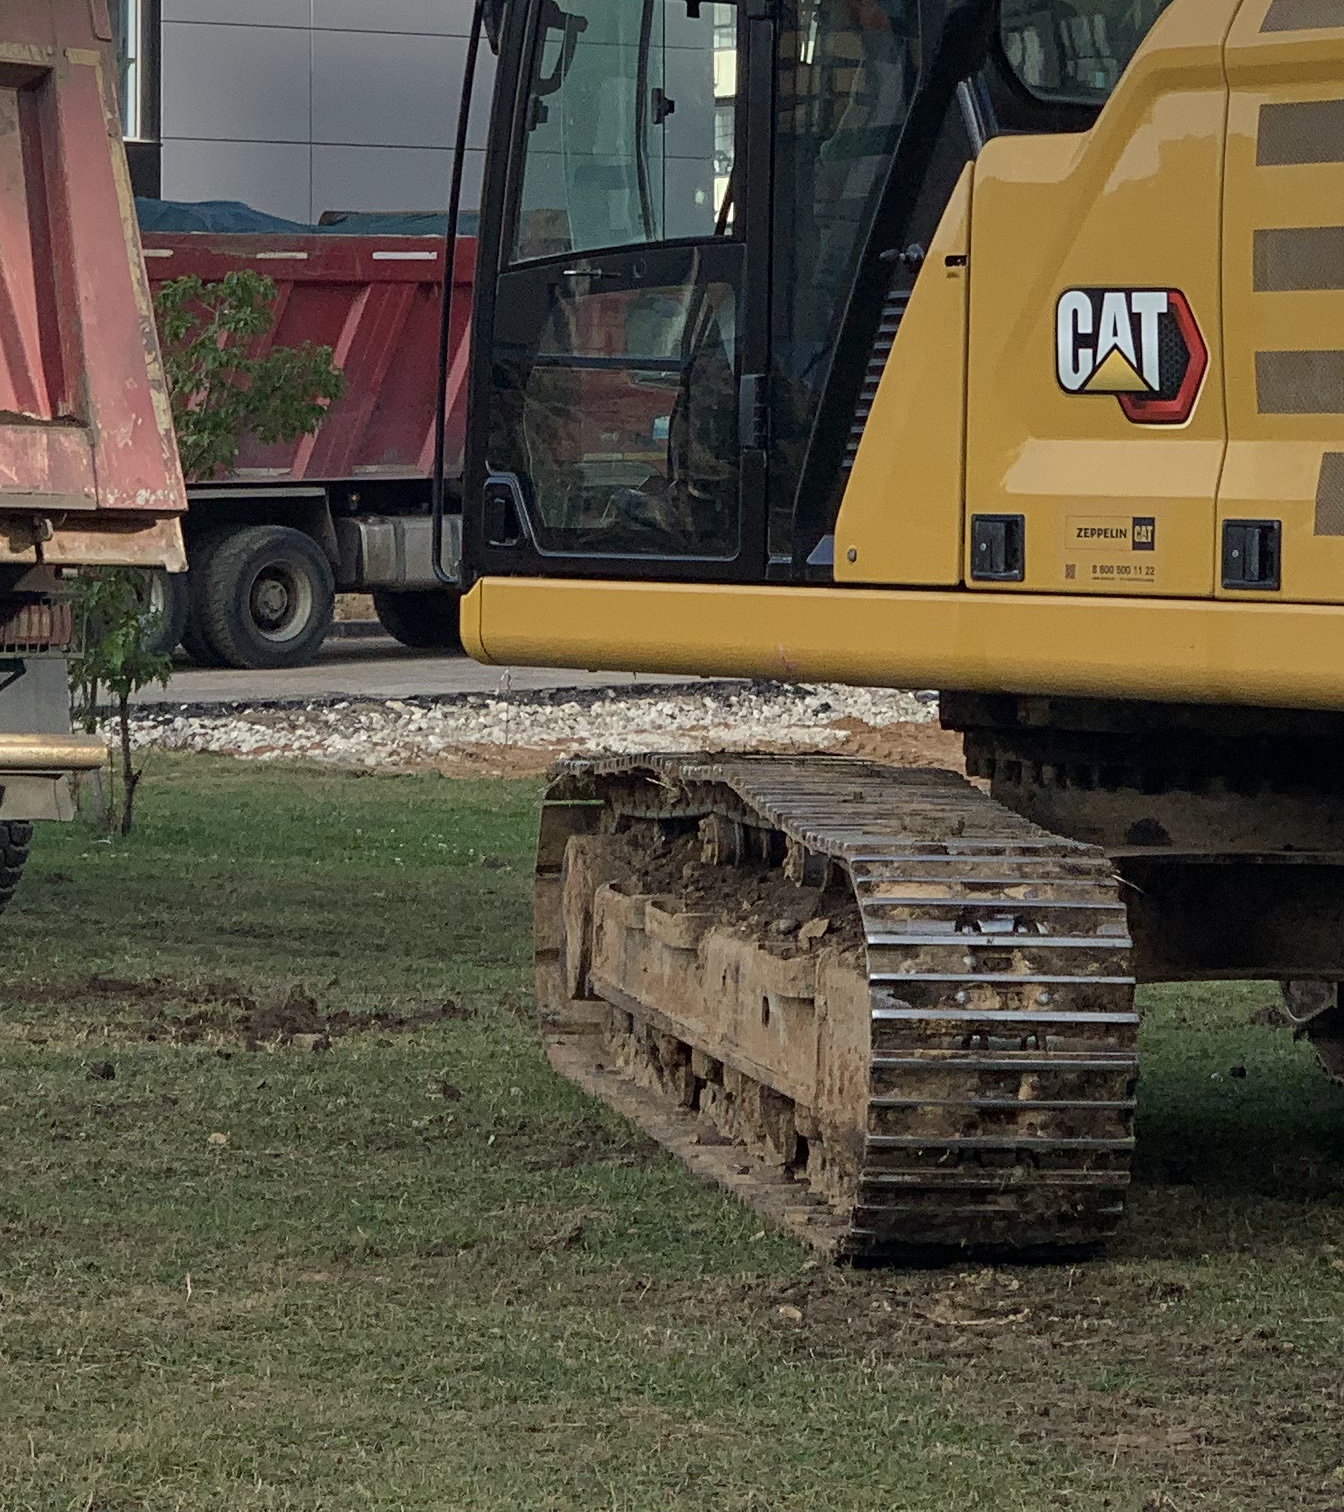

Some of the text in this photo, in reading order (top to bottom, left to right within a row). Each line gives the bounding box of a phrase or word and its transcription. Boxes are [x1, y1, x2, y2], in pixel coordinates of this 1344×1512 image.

[1057, 291, 1168, 392] CAT
[1076, 525, 1153, 543] ZEPPELIN CAT
